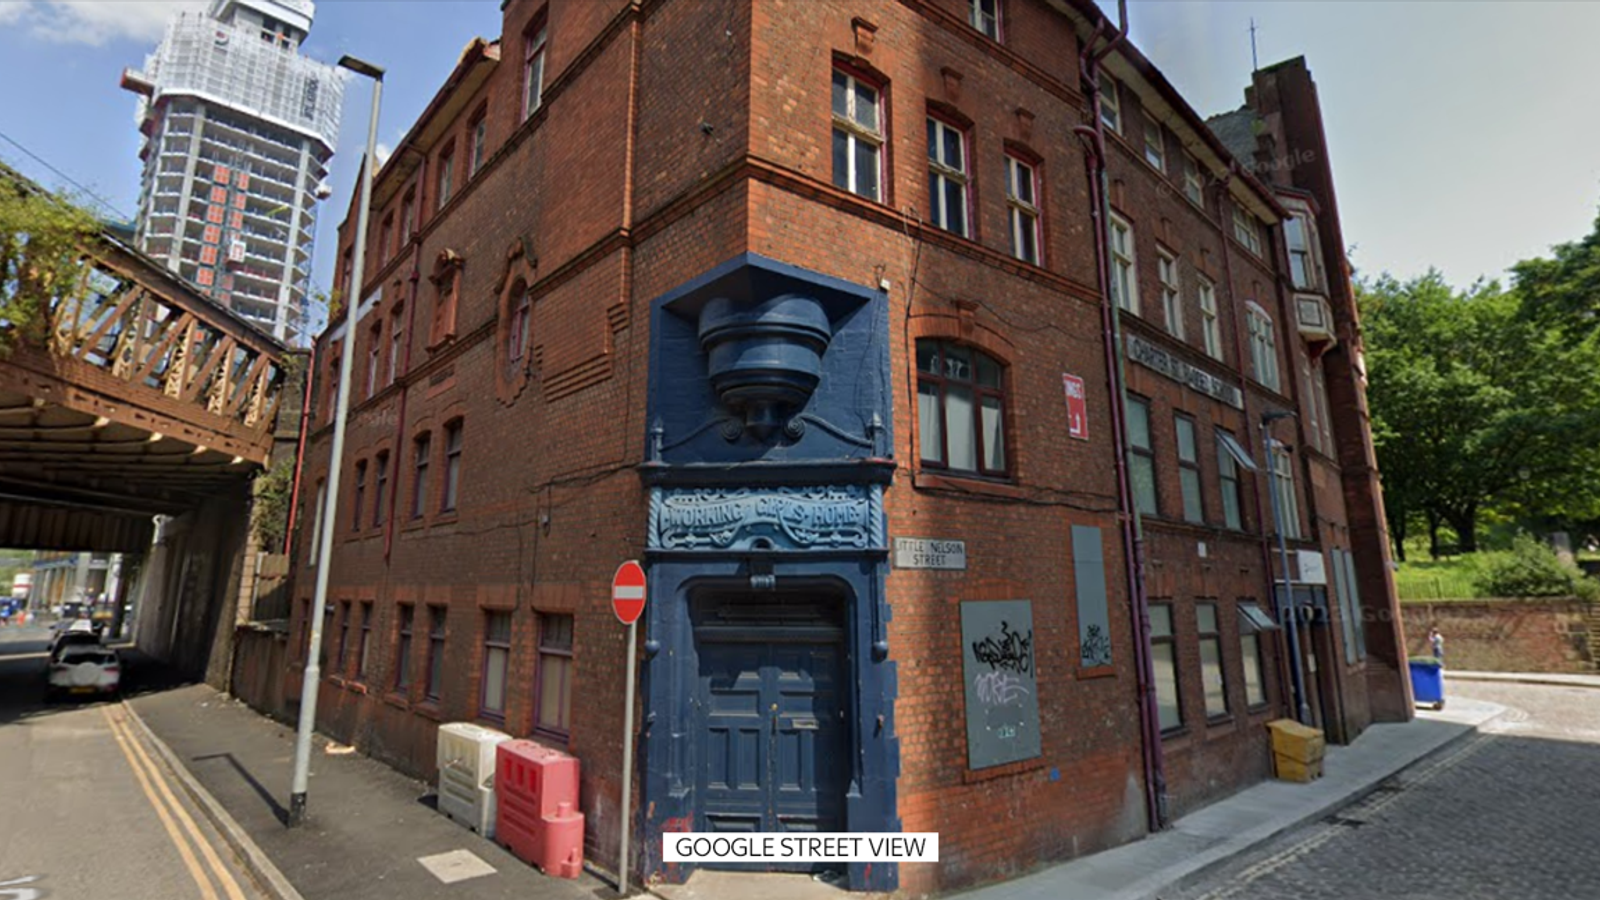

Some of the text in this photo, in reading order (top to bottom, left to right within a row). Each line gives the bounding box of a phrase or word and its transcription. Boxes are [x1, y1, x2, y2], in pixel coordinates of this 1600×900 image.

[669, 504, 743, 528] WORKING
[931, 541, 963, 554] NELSON
[913, 553, 946, 566] STREET
